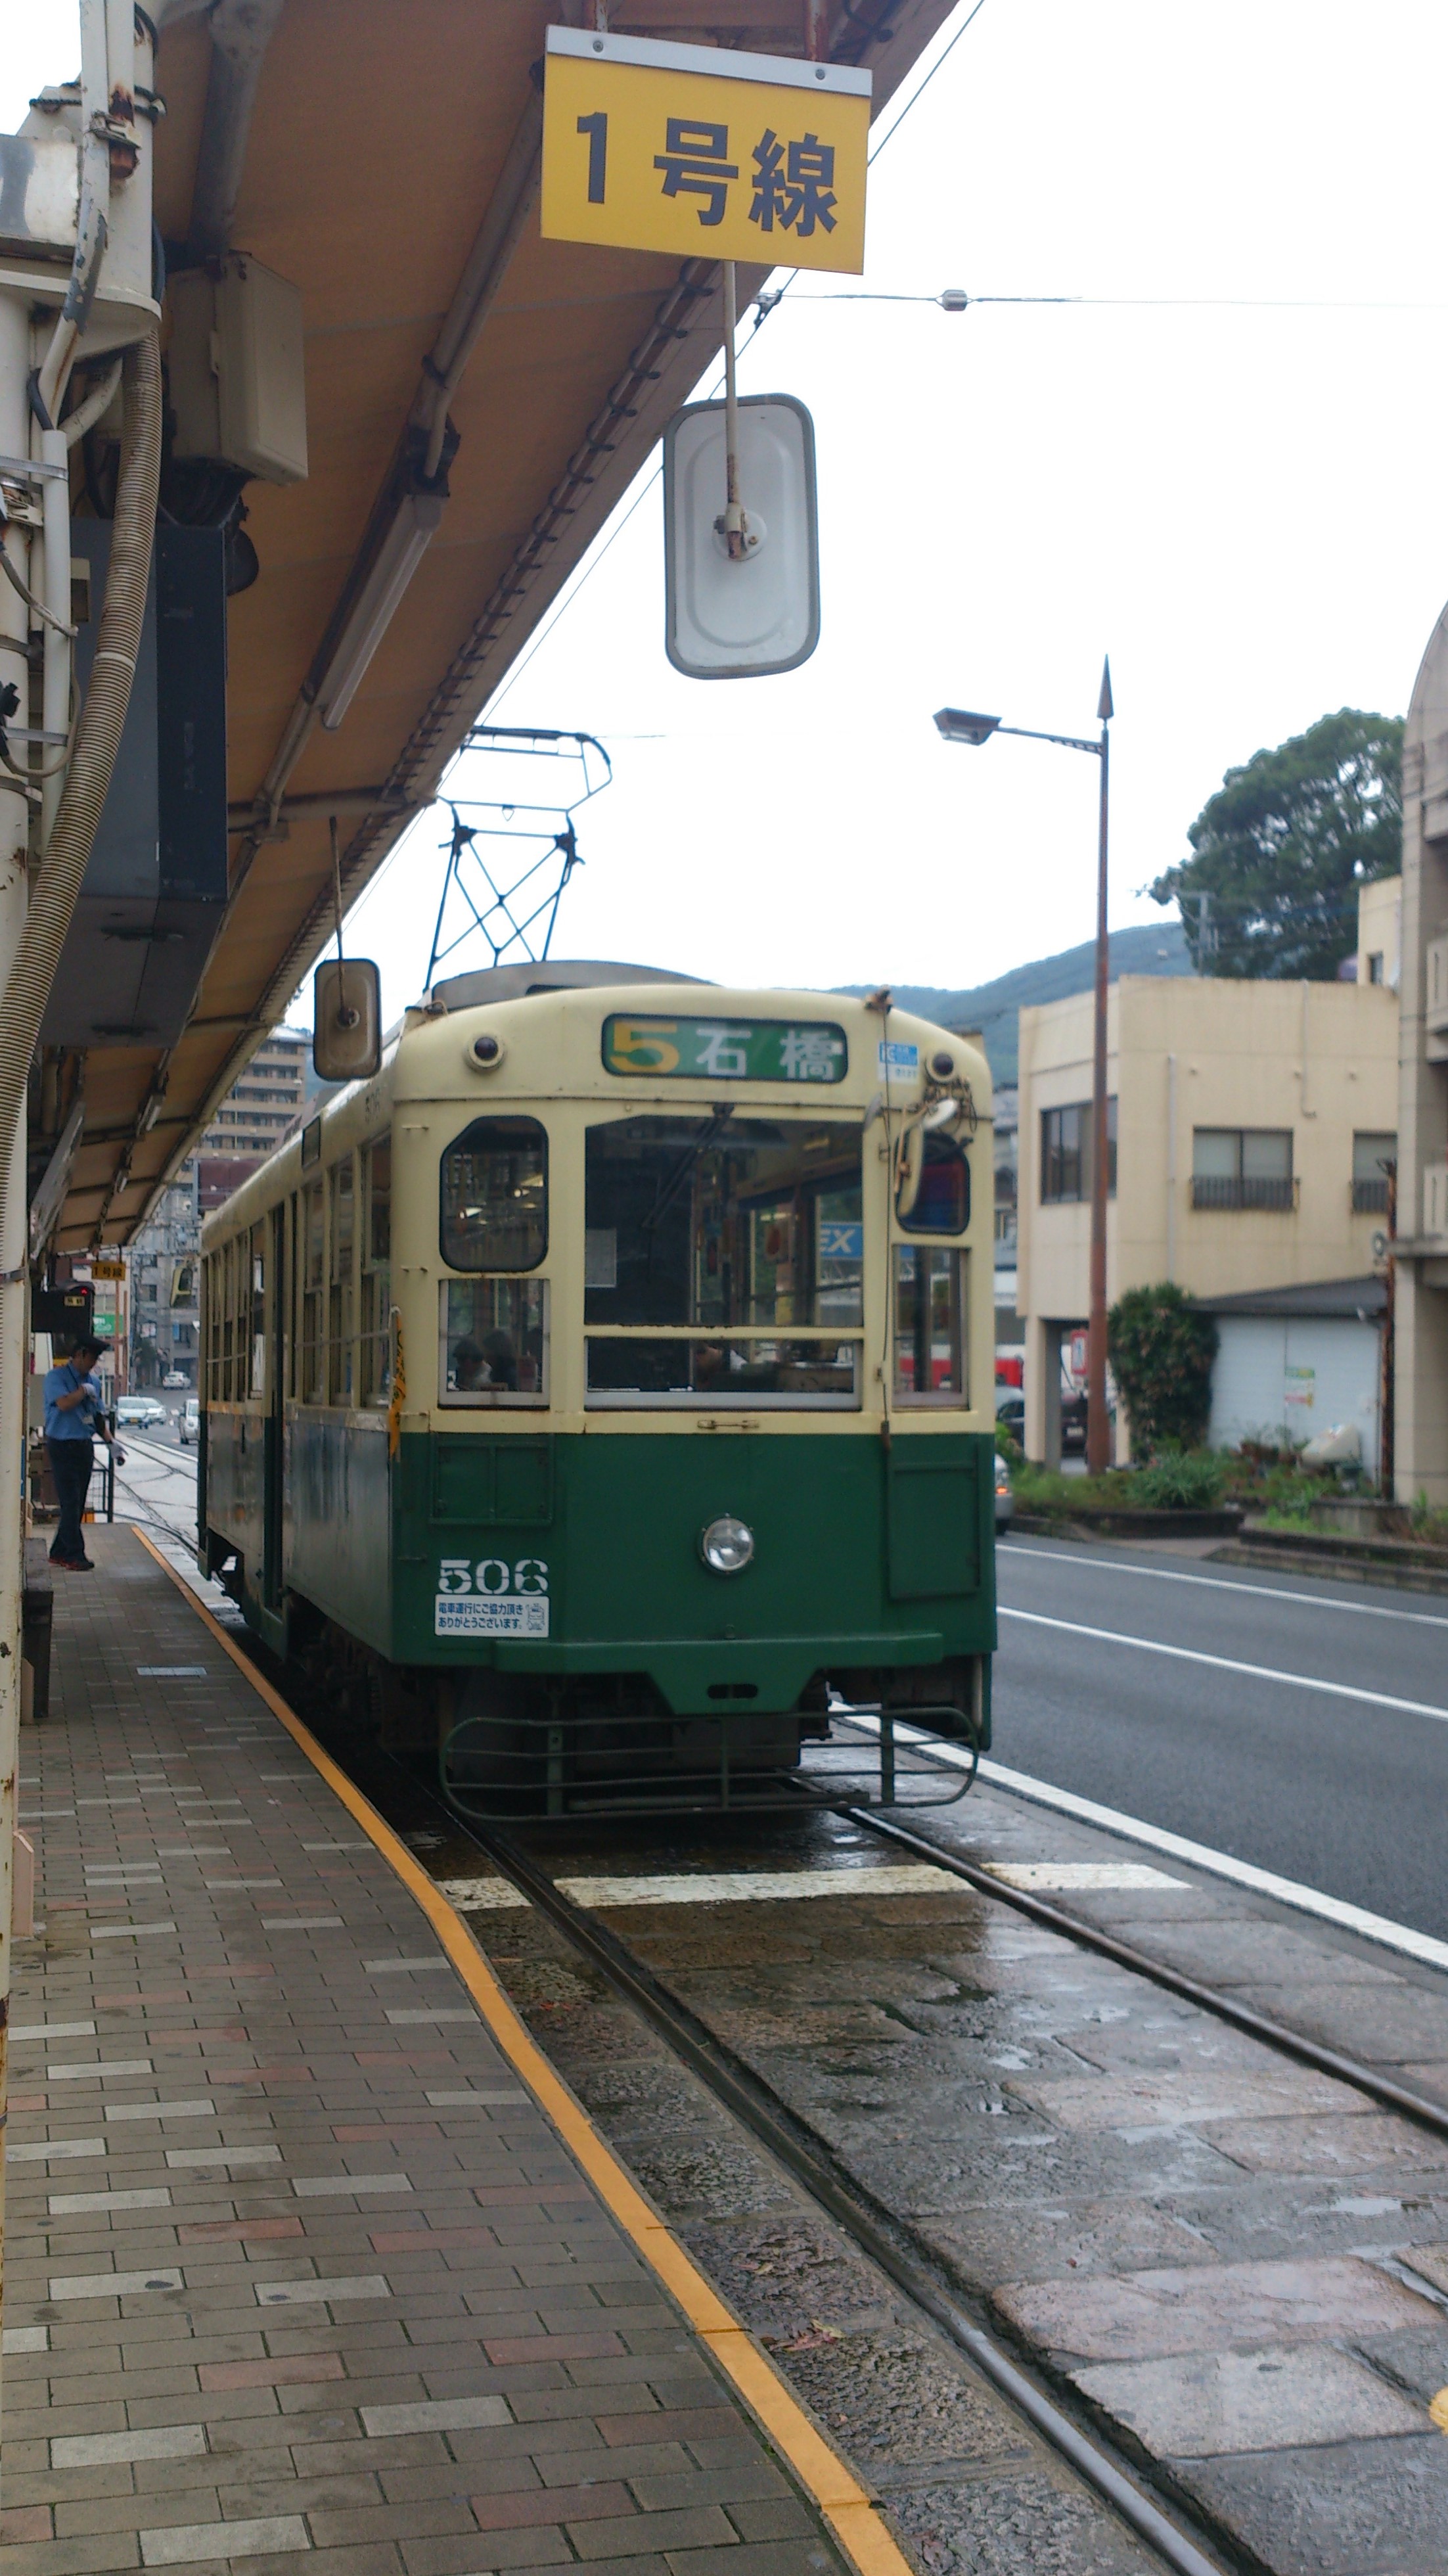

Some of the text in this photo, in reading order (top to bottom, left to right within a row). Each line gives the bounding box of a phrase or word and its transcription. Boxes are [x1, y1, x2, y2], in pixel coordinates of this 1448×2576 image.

[577, 112, 838, 237] 1号線
[610, 1021, 836, 1080] 5 石橋
[438, 1559, 548, 1595] 506
